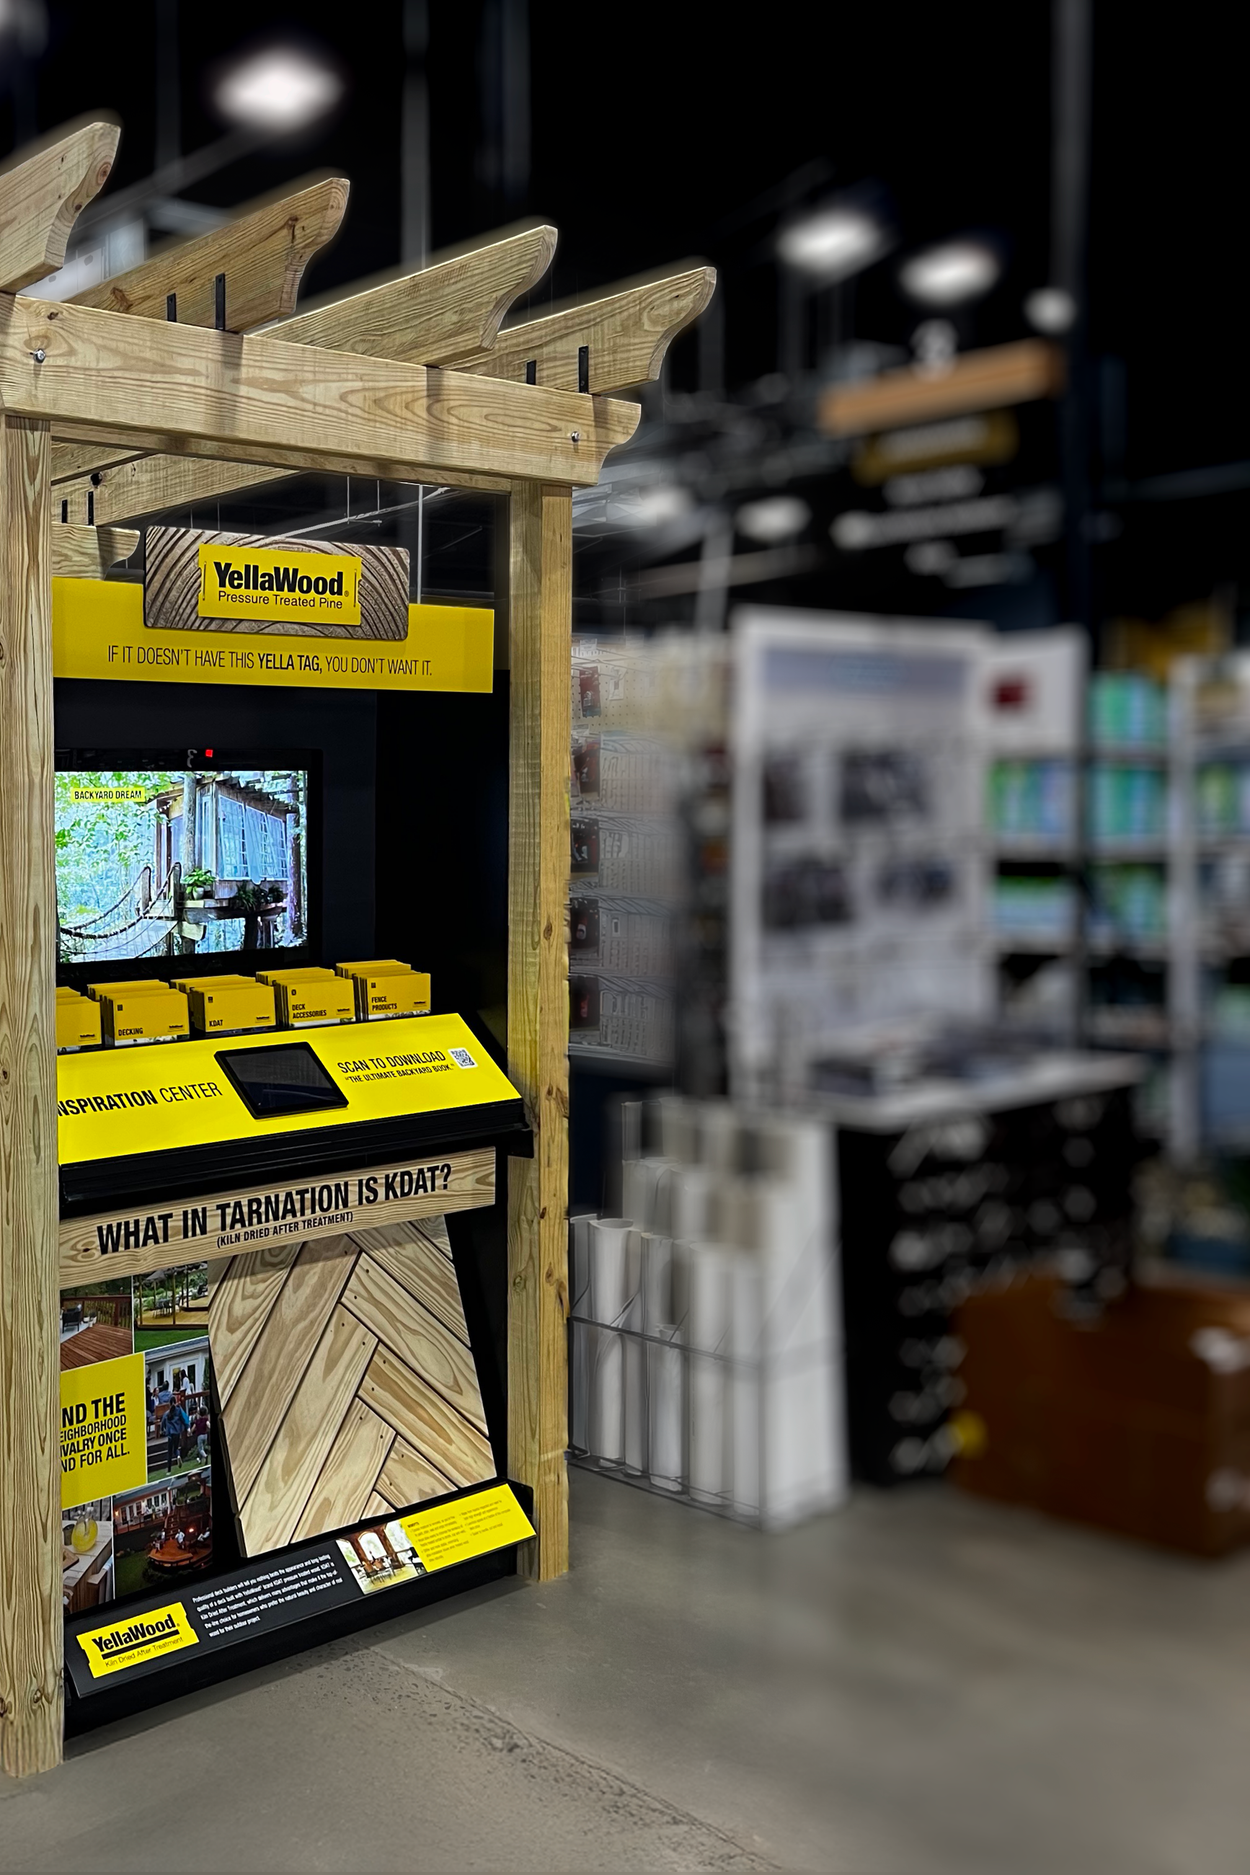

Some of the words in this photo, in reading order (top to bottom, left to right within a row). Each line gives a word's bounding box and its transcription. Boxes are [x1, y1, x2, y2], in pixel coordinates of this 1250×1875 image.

[218, 590, 270, 605] Pressure
[272, 594, 316, 608] Treated
[319, 597, 343, 609] Pine
[108, 645, 119, 663] IF
[122, 646, 133, 664] IT
[137, 646, 191, 666] DOESN'T
[195, 649, 226, 668] HAVE
[228, 651, 254, 669] THIS
[258, 652, 295, 671] YELLA
[297, 654, 323, 675] TAG,
[325, 656, 348, 673] YOU
[351, 657, 385, 674] DON'T
[387, 659, 419, 675] WANT
[422, 660, 432, 676] IT.
[74, 790, 114, 800] BACKYARD
[115, 789, 142, 799] DREAM
[292, 1003, 306, 1011] DECK
[292, 1010, 327, 1019] ACCESSORIES
[371, 1002, 398, 1011] PRODUCTS
[118, 1027, 144, 1036] DECKING
[337, 1058, 371, 1074] SCAN
[368, 1056, 386, 1069] TO
[386, 1050, 447, 1066] DOWNLOAD
[364, 1070, 398, 1082] ULTIMATE
[397, 1065, 432, 1077] BACKYARD
[58, 1089, 159, 1117] NSPIRATION
[159, 1081, 223, 1103] CENTER
[96, 1212, 174, 1255] WHAT
[182, 1206, 208, 1239] IN
[216, 1181, 349, 1232] TARNATION
[358, 1176, 379, 1206] IS
[384, 1163, 452, 1201] KDAT?
[216, 1232, 241, 1249] (KILN
[243, 1227, 270, 1242] DRIED
[272, 1221, 299, 1236] AFTER
[301, 1211, 354, 1230] TREATMENT)
[61, 1403, 87, 1429] ND
[91, 1391, 126, 1420] THE
[60, 1414, 127, 1443] EIGHBORHOOD
[60, 1436, 96, 1458] IVALRY
[97, 1427, 127, 1447] ONCE
[61, 1457, 76, 1473] ND
[80, 1449, 103, 1469] FOR
[106, 1443, 130, 1461] ALL.
[104, 1658, 118, 1668] Kiln
[119, 1653, 136, 1664] Dried
[137, 1647, 152, 1658] After
[153, 1636, 184, 1652] Treatment
